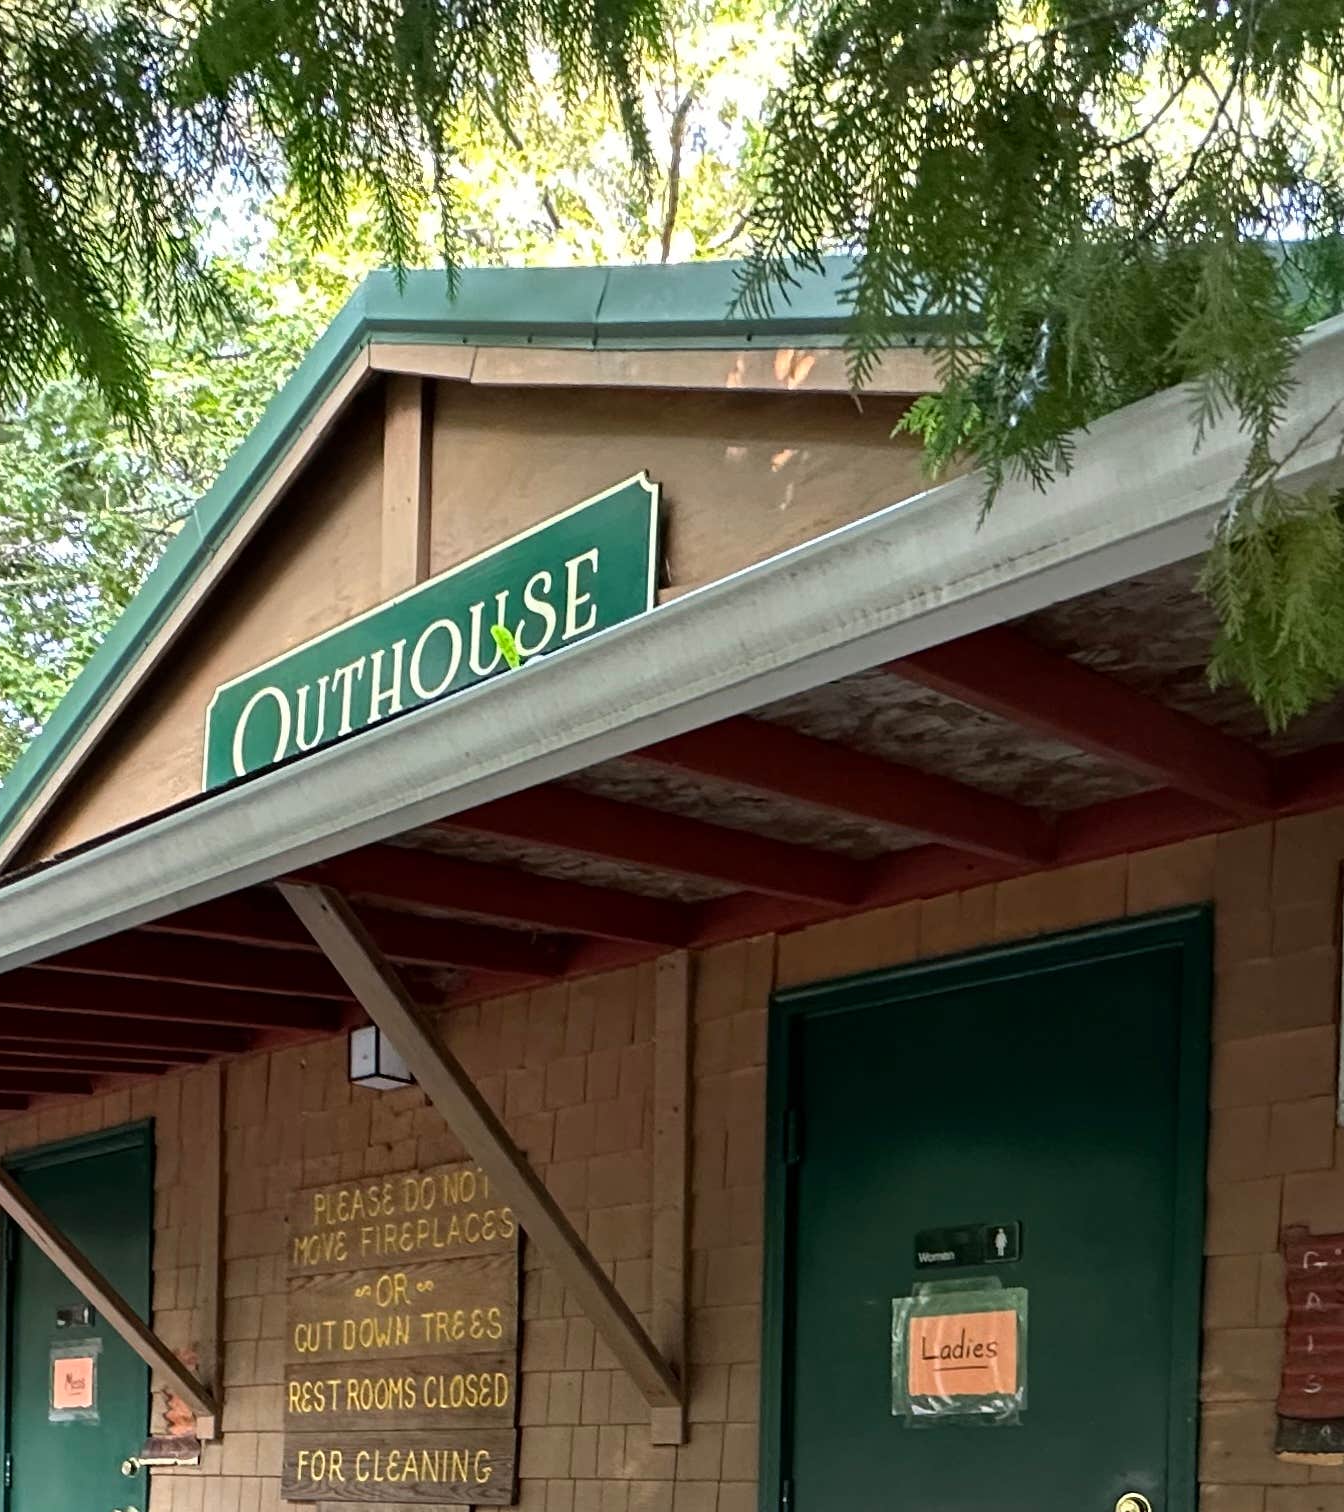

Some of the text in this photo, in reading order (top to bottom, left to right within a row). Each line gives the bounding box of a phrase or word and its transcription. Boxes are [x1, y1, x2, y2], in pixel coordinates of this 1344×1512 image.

[232, 548, 599, 777] OUTHOUSE
[314, 1184, 395, 1226] PLEASE
[404, 1177, 436, 1212] DO
[293, 1208, 515, 1267] MOVE FIREPLACES
[376, 1273, 412, 1307] OR
[294, 1308, 503, 1353] CUT DOWN TREES
[921, 1328, 999, 1361] Ladies
[289, 1373, 509, 1414] REST ROOMS CLOSED
[297, 1450, 493, 1484] FOR CLEANING
